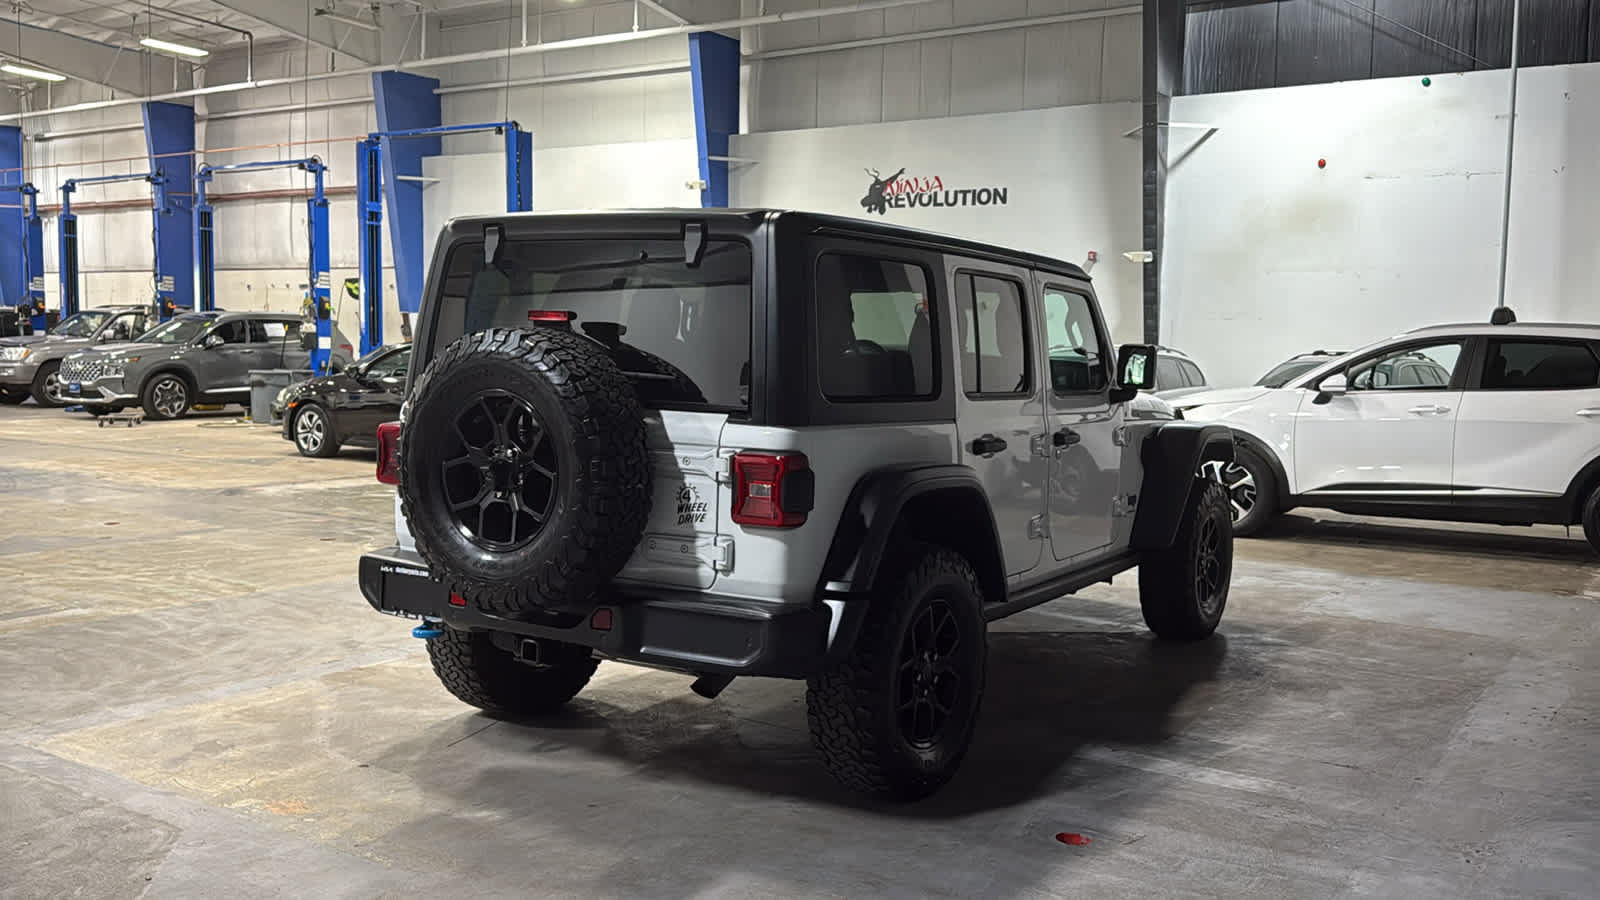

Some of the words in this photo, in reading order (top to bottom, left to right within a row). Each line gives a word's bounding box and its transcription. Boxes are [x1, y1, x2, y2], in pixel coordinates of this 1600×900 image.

[883, 187, 1008, 208] REVOLUTION
[682, 489, 691, 503] 4
[677, 502, 708, 514] WHEEL
[678, 513, 707, 525] DRIVE
